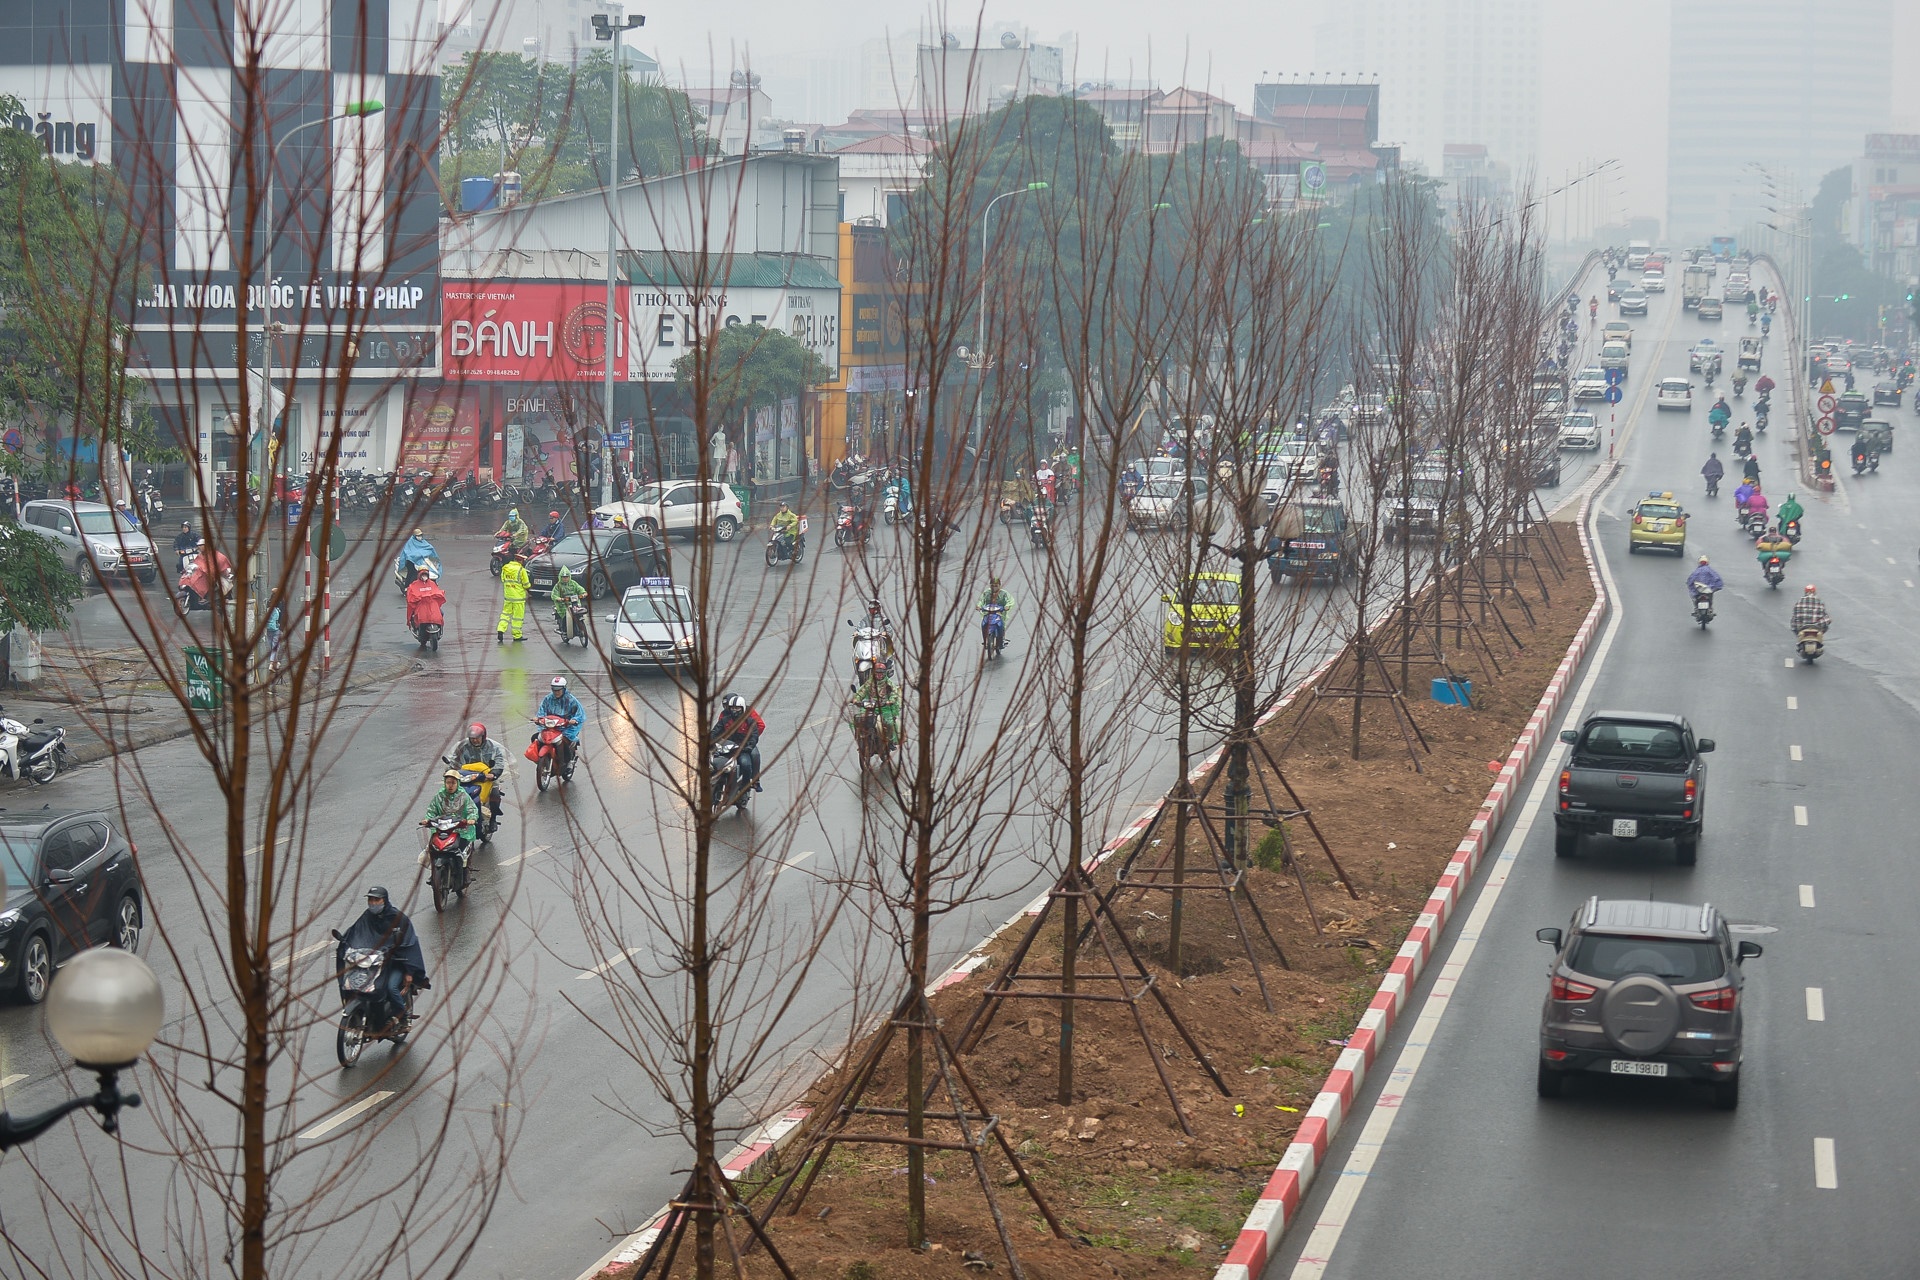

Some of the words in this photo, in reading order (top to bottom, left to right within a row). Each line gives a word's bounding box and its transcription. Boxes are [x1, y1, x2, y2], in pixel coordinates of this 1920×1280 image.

[12, 112, 96, 160] Răng
[246, 277, 294, 311] QUỐC
[373, 279, 424, 310] PHÁP
[487, 293, 515, 301] VIETNAM
[674, 293, 728, 308] TRANG
[451, 308, 554, 358] BÁNH
[507, 394, 546, 413] BÁNH
[301, 451, 314, 462] 24
